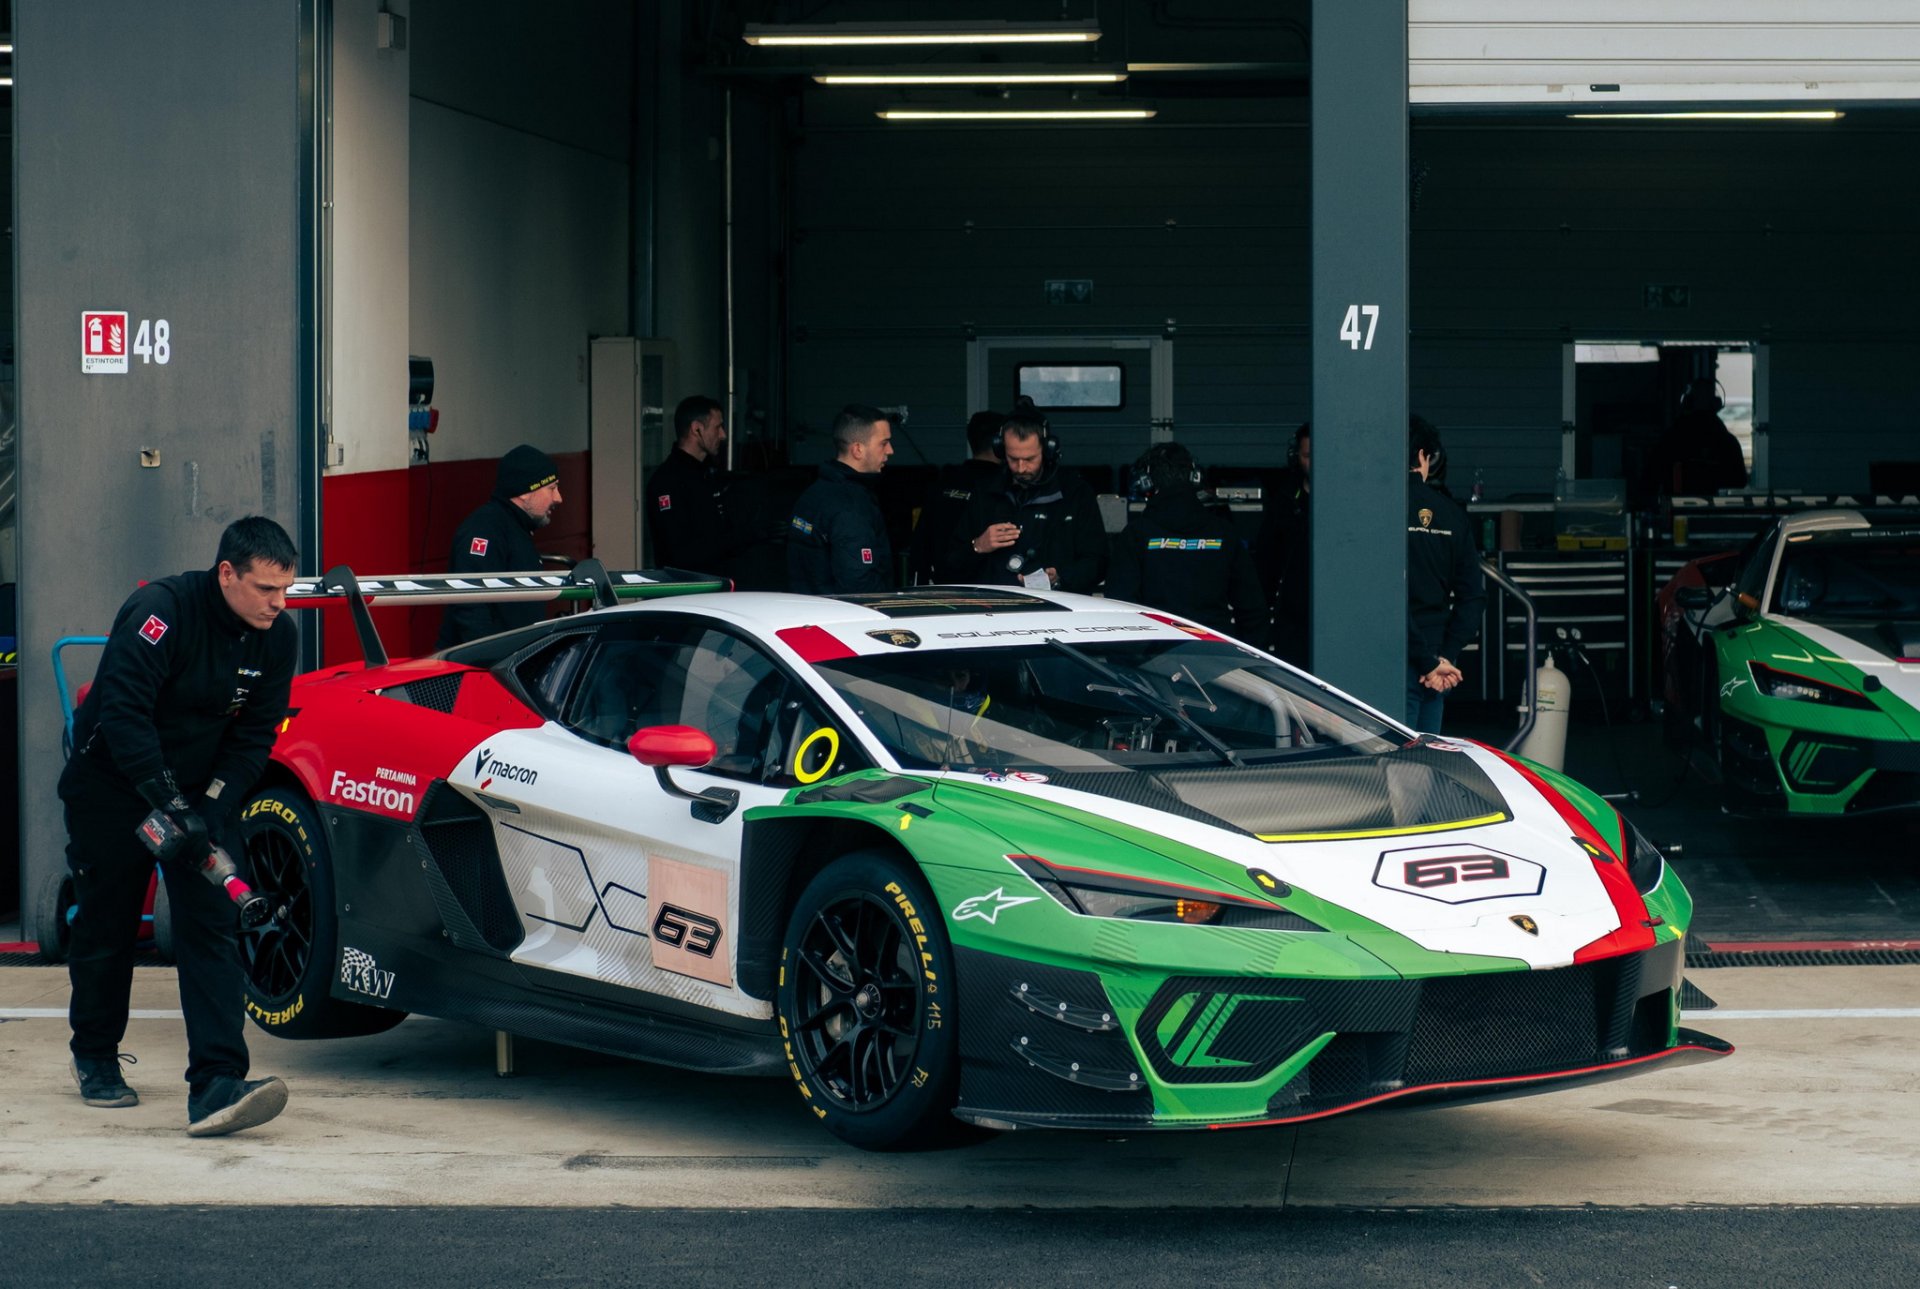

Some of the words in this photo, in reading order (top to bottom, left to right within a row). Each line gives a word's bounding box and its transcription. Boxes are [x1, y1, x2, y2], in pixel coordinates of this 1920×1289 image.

[133, 318, 171, 365] 48
[1340, 304, 1380, 350] 47
[937, 628, 1069, 639] SQUADRA
[1074, 625, 1159, 633] CORSE
[375, 767, 417, 786] PERTAMINA
[487, 759, 539, 785] macron
[329, 770, 414, 814] Fastron
[249, 799, 297, 823] ZERO
[1403, 853, 1511, 889] 63
[651, 901, 723, 959] 63
[884, 881, 937, 981] PIRELLI
[348, 964, 396, 999] KW
[246, 993, 304, 1025] PIRELLI
[927, 1002, 942, 1030] 115
[911, 1066, 930, 1089] FR
